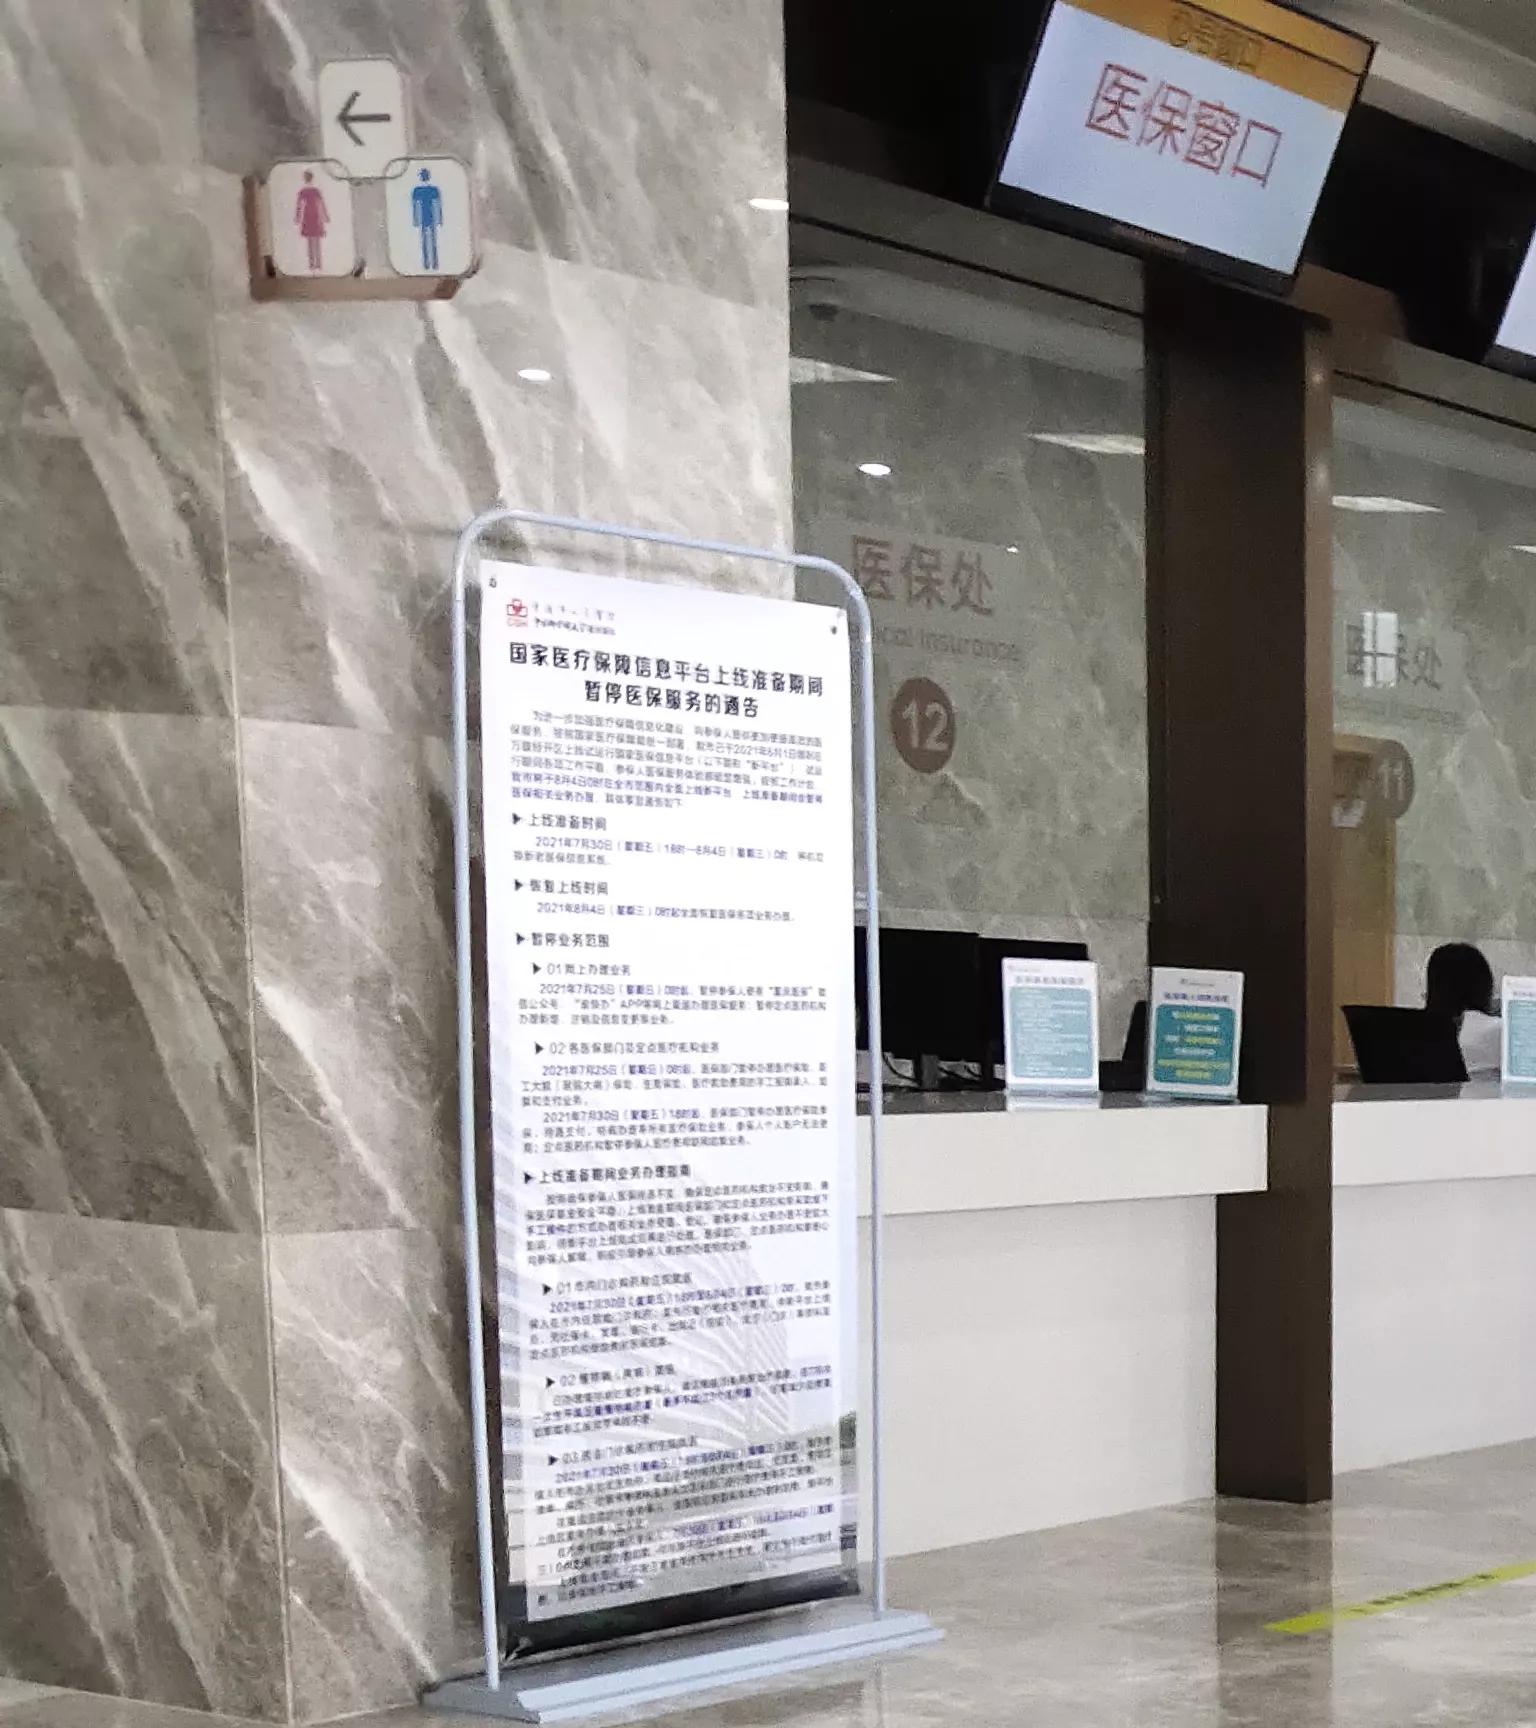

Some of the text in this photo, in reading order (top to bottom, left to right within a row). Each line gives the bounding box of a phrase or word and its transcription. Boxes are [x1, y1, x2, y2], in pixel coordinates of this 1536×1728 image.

[1085, 62, 1284, 189] 医保窗口
[851, 533, 995, 616] 医保处
[509, 641, 824, 698] 国家医疗保障信息平台上线准备期间
[584, 679, 760, 719] 暂停医保服务的通告
[899, 698, 951, 754] 12
